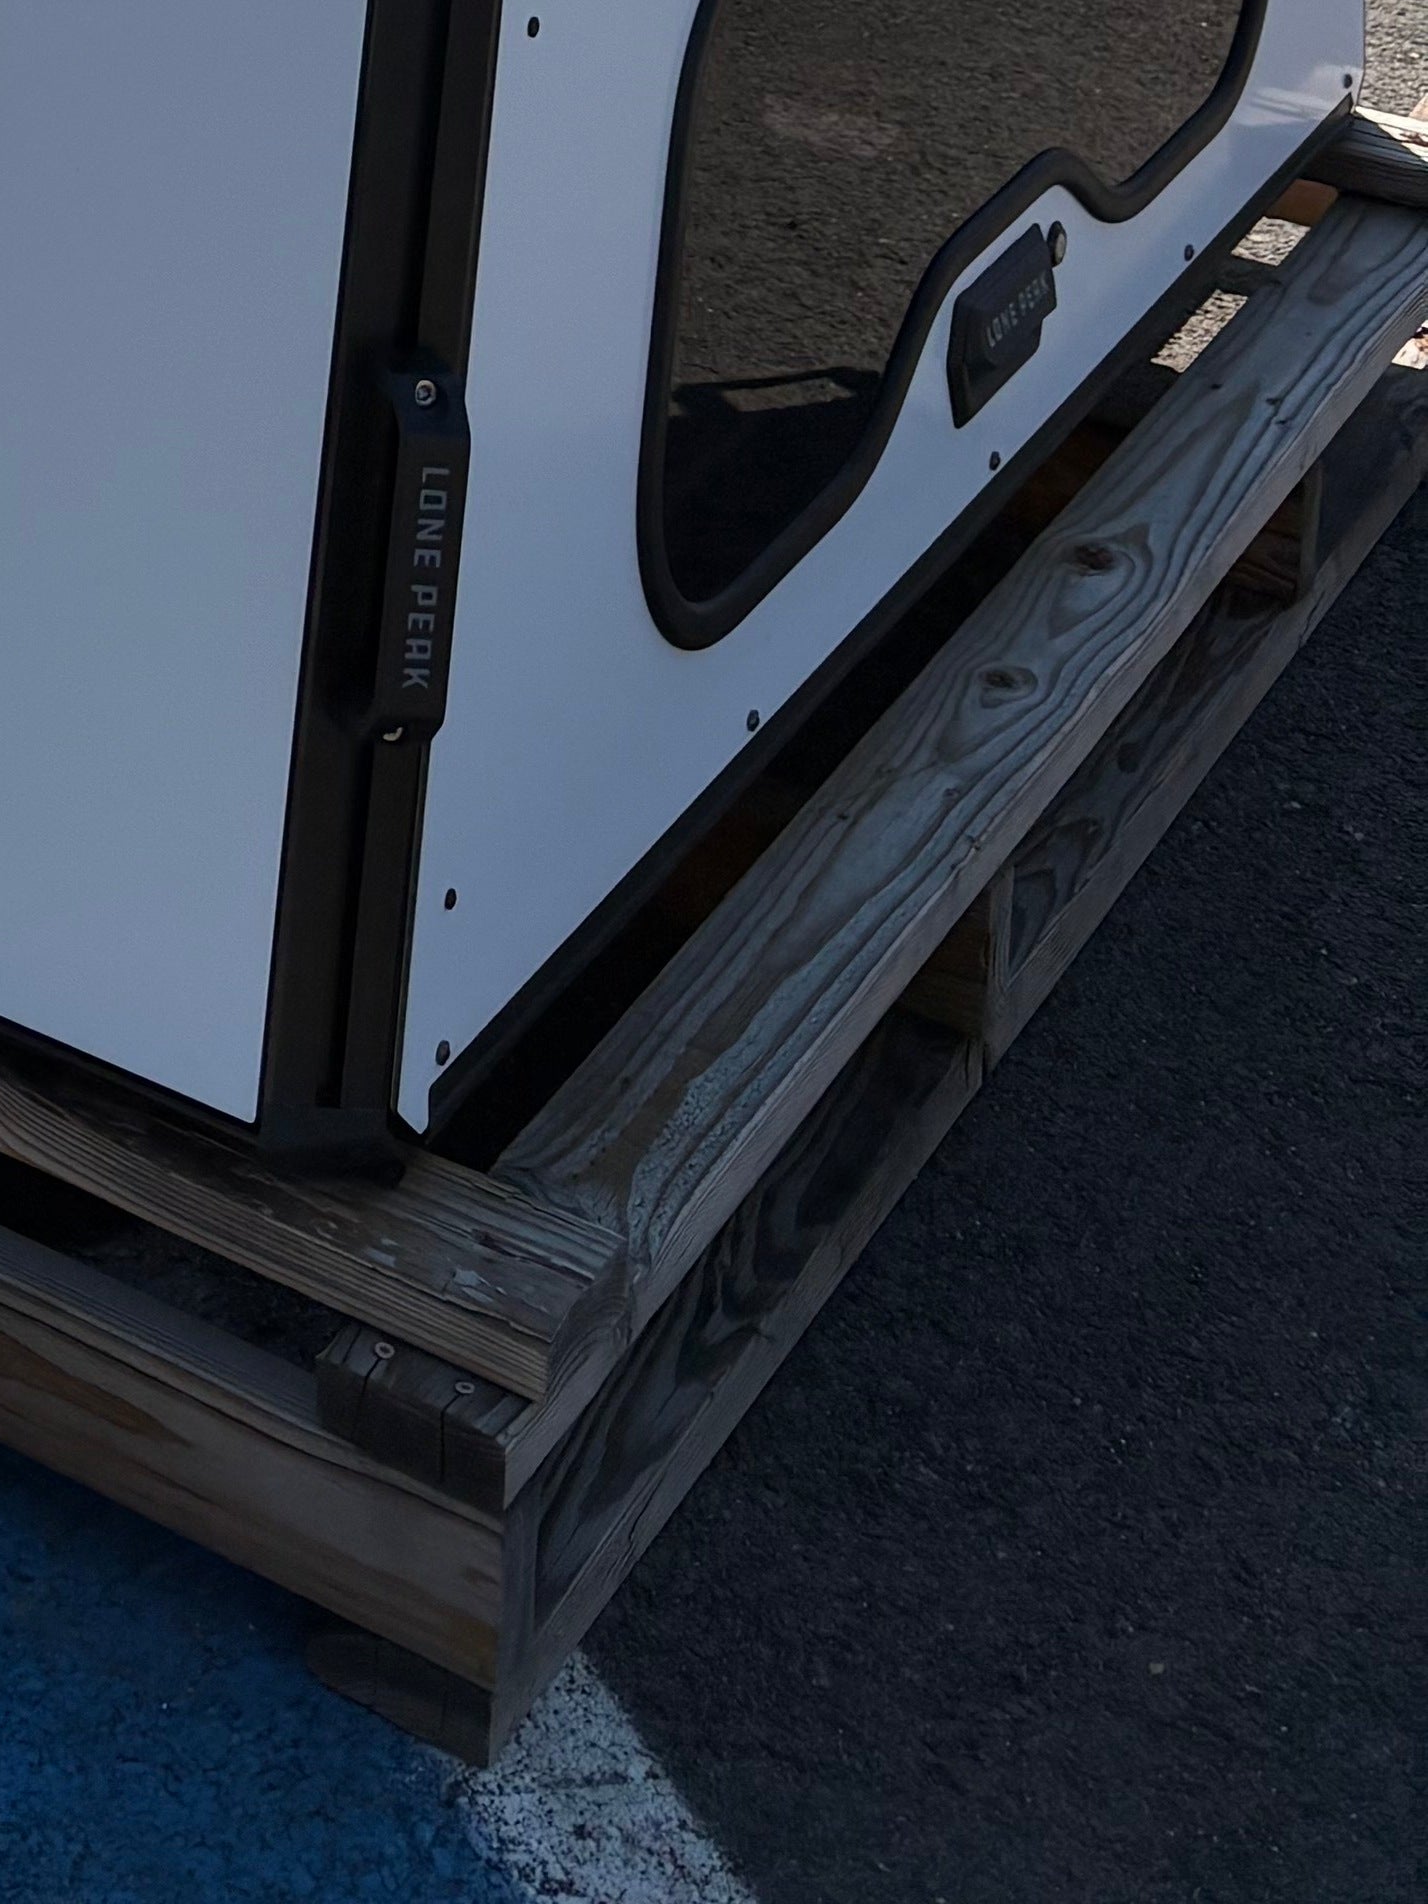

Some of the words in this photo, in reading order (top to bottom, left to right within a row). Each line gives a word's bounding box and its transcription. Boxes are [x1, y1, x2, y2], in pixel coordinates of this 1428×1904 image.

[986, 302, 1018, 348] LONE
[413, 467, 450, 568] LONE
[402, 584, 439, 689] PEAK
